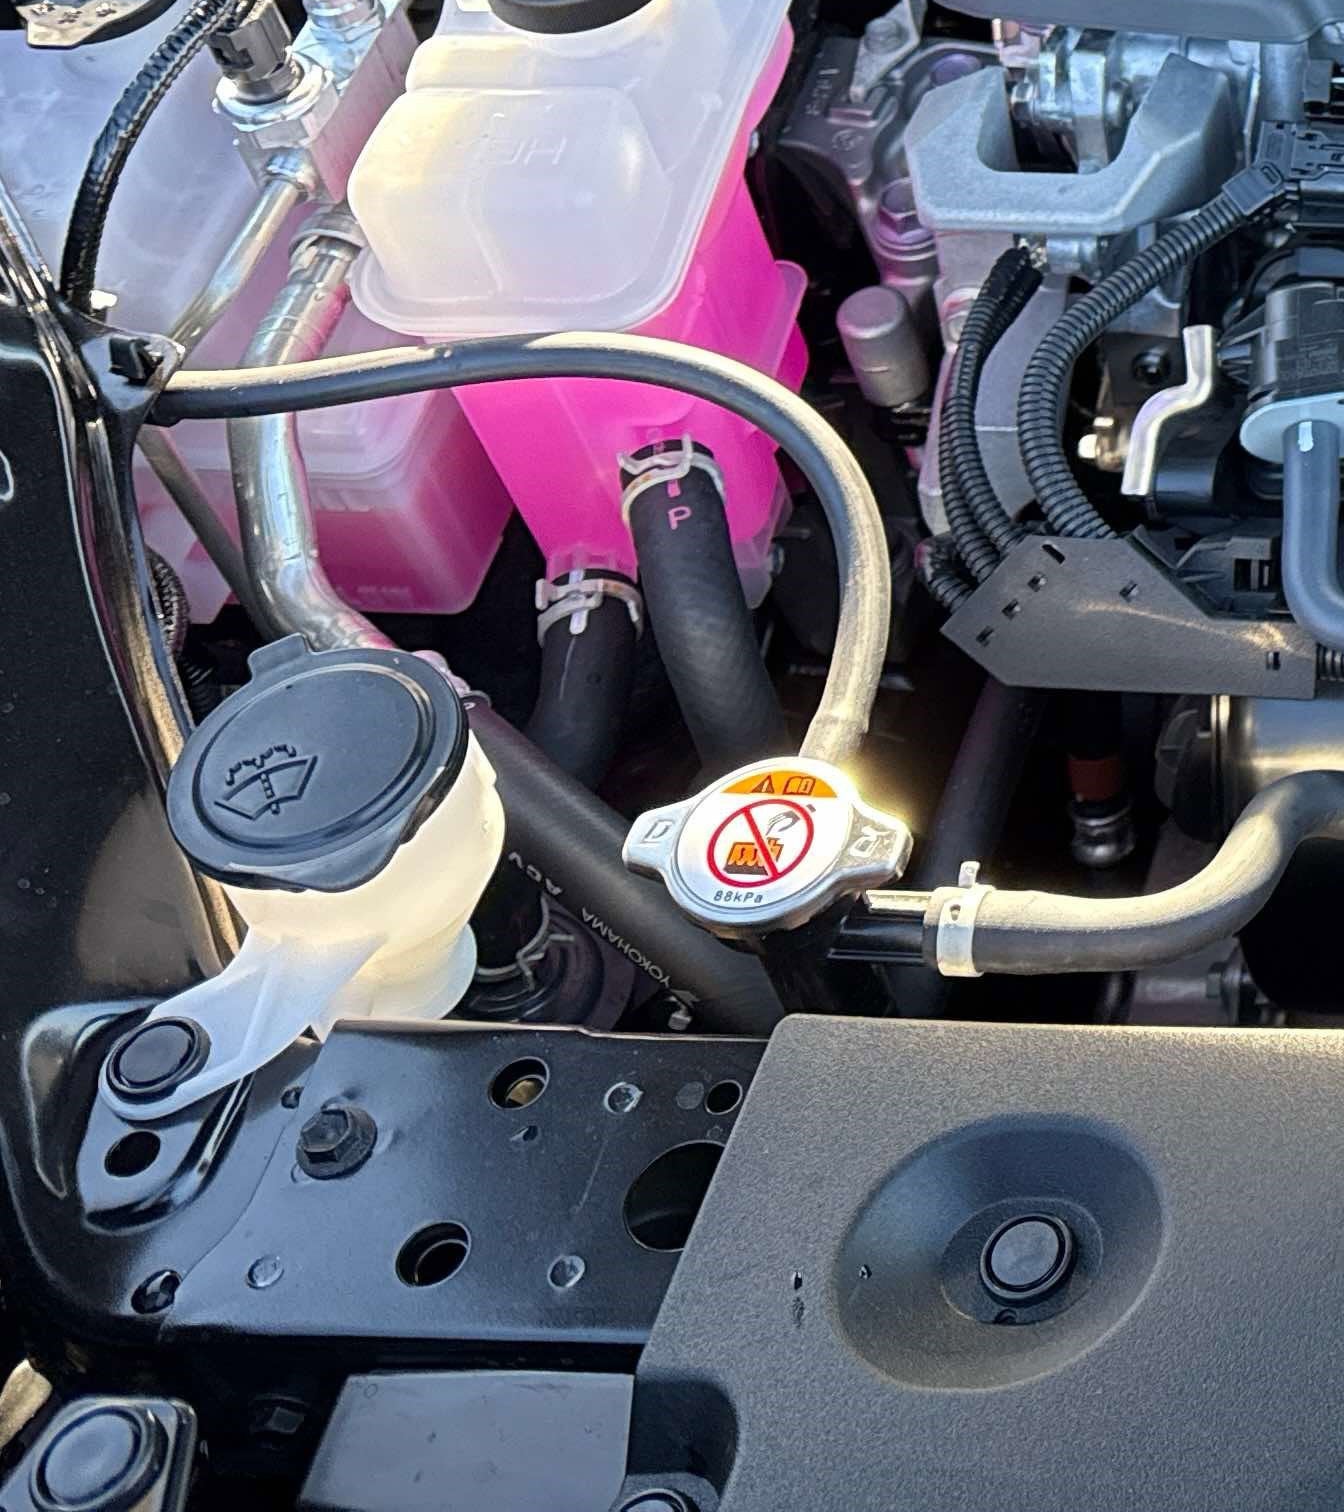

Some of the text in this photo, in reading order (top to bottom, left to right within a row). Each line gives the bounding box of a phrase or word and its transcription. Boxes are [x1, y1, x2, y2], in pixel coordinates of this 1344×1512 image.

[667, 506, 692, 531] P
[713, 889, 764, 904] 88kPa
[581, 906, 673, 988] YOKOHAMA
